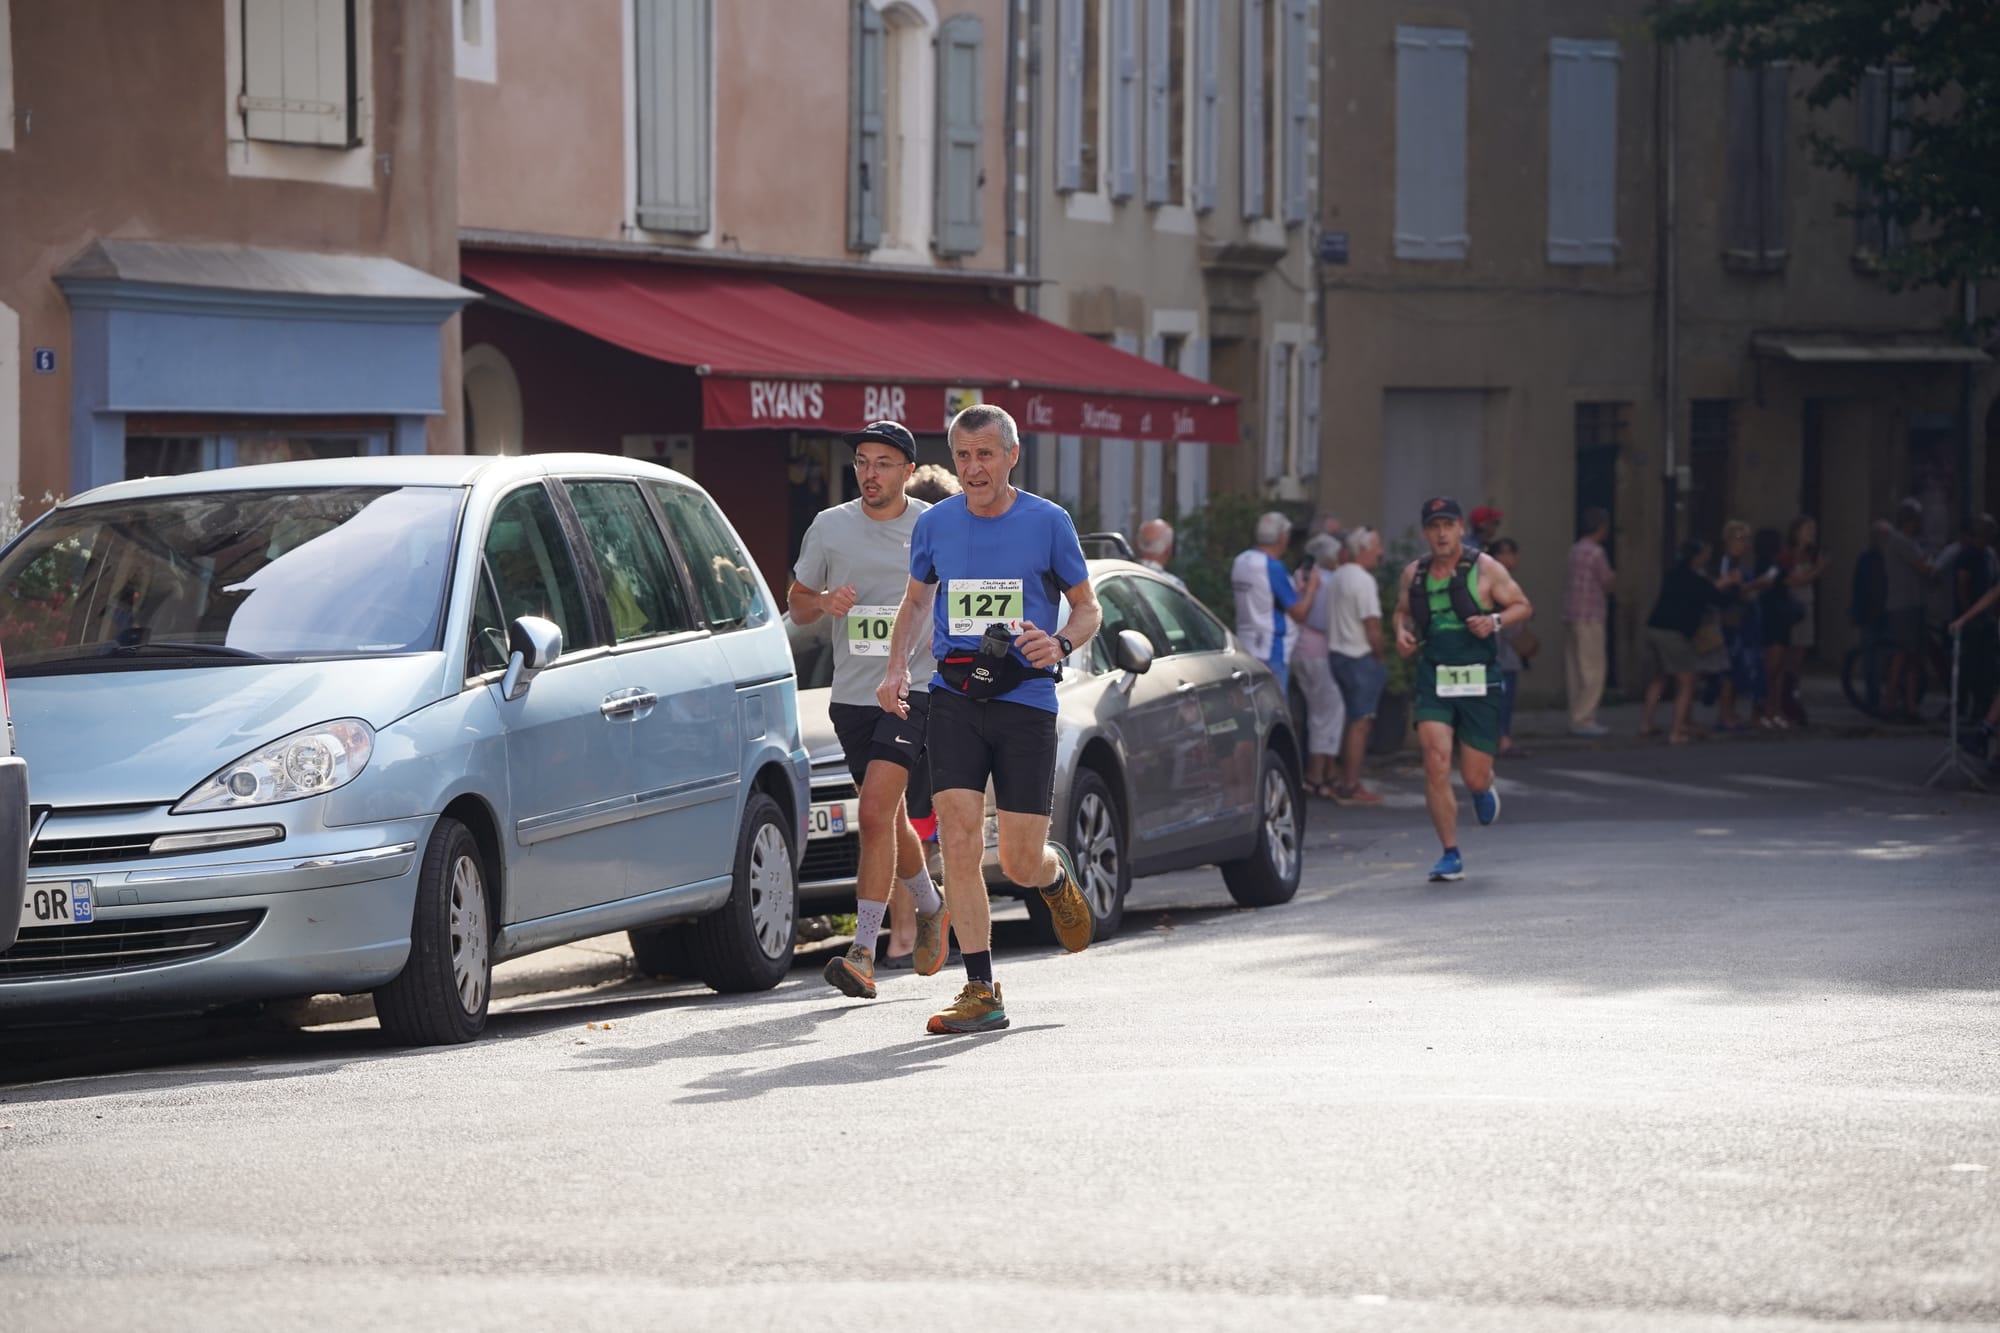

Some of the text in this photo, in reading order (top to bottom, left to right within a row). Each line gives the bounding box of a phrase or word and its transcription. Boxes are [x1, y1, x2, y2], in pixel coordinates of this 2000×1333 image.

[41, 351, 49, 369] 6
[750, 380, 906, 422] RYAN'S BAR
[959, 594, 1012, 617] 127
[857, 618, 894, 640] 10
[1449, 670, 1470, 685] 11
[74, 901, 91, 917] 59
